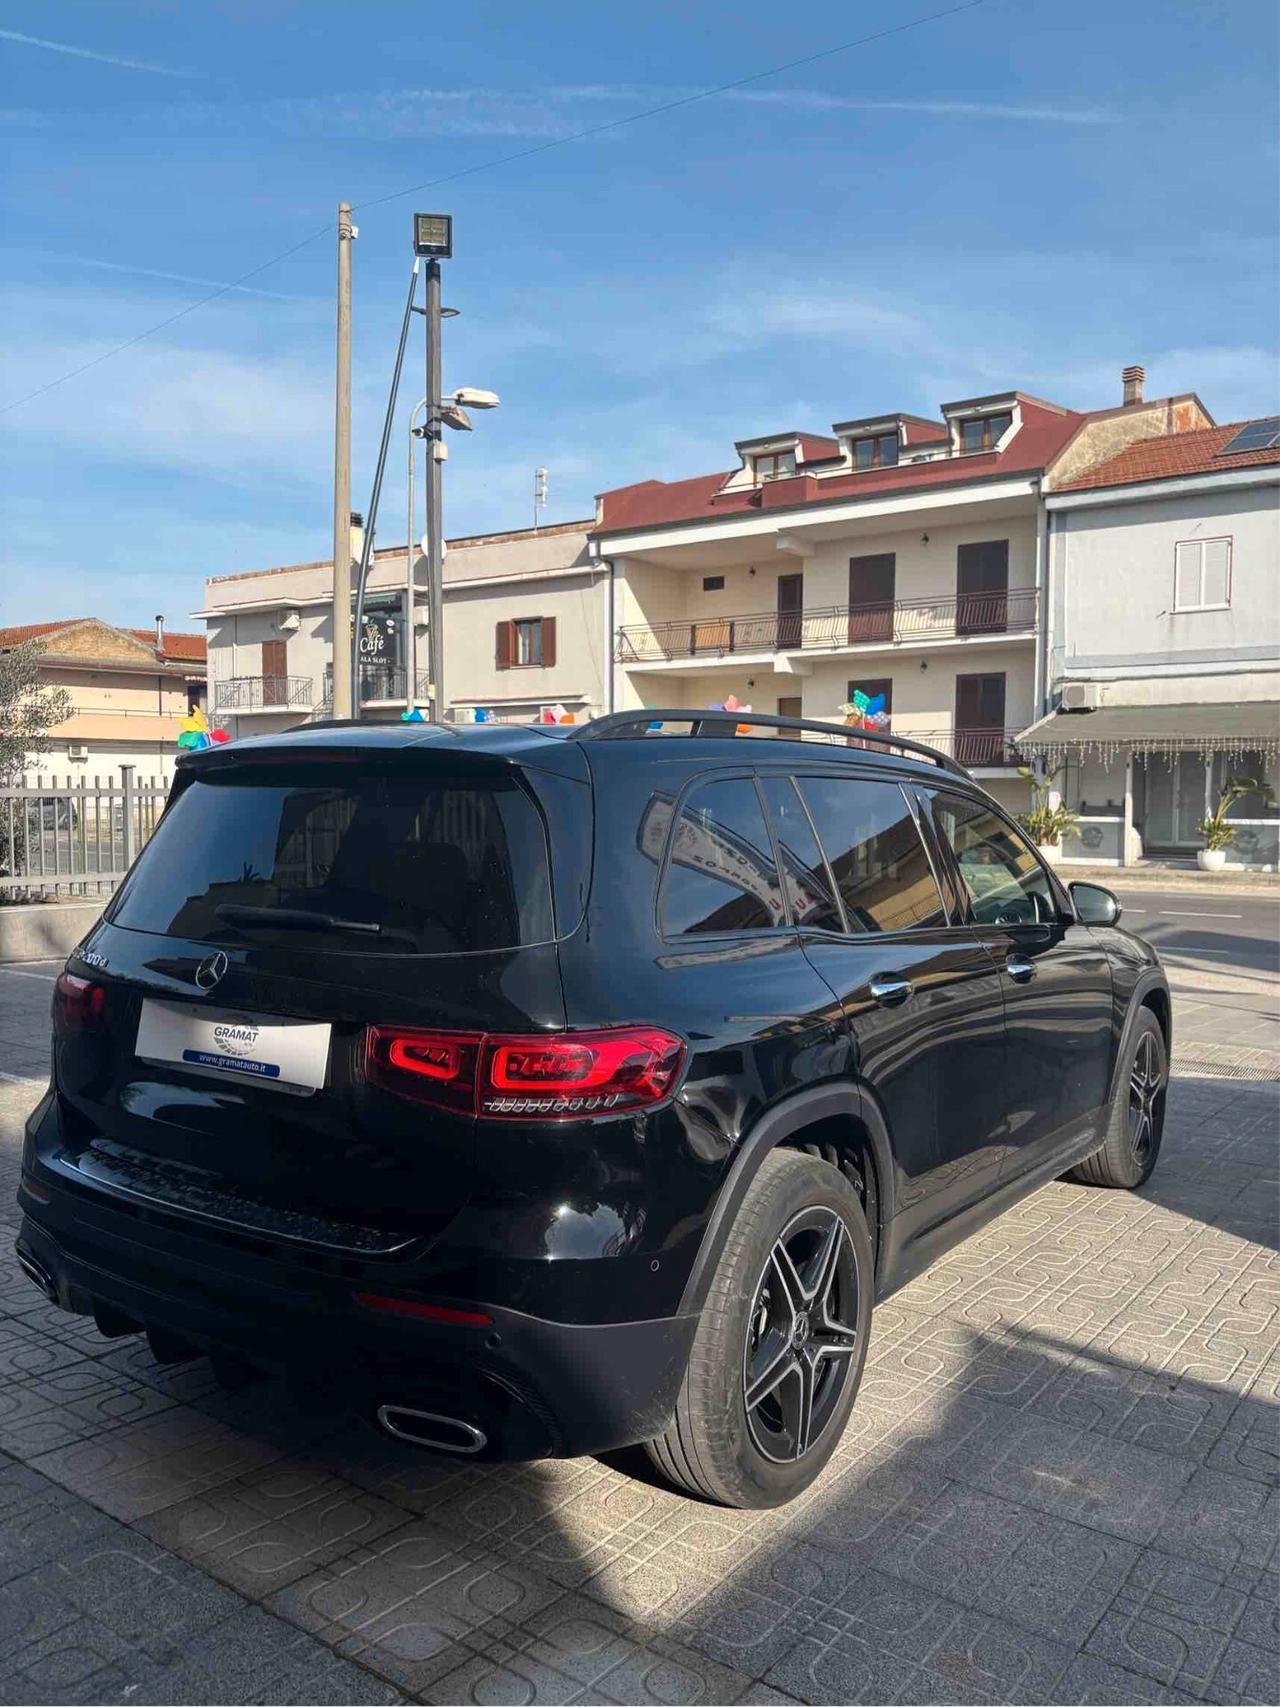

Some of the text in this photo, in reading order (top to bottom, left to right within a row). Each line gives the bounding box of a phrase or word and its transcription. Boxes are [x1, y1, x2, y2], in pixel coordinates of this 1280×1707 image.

[360, 634, 384, 655] Café
[214, 1026, 259, 1042] GRAMAT
[199, 1054, 266, 1073] www.gramatauto.it
